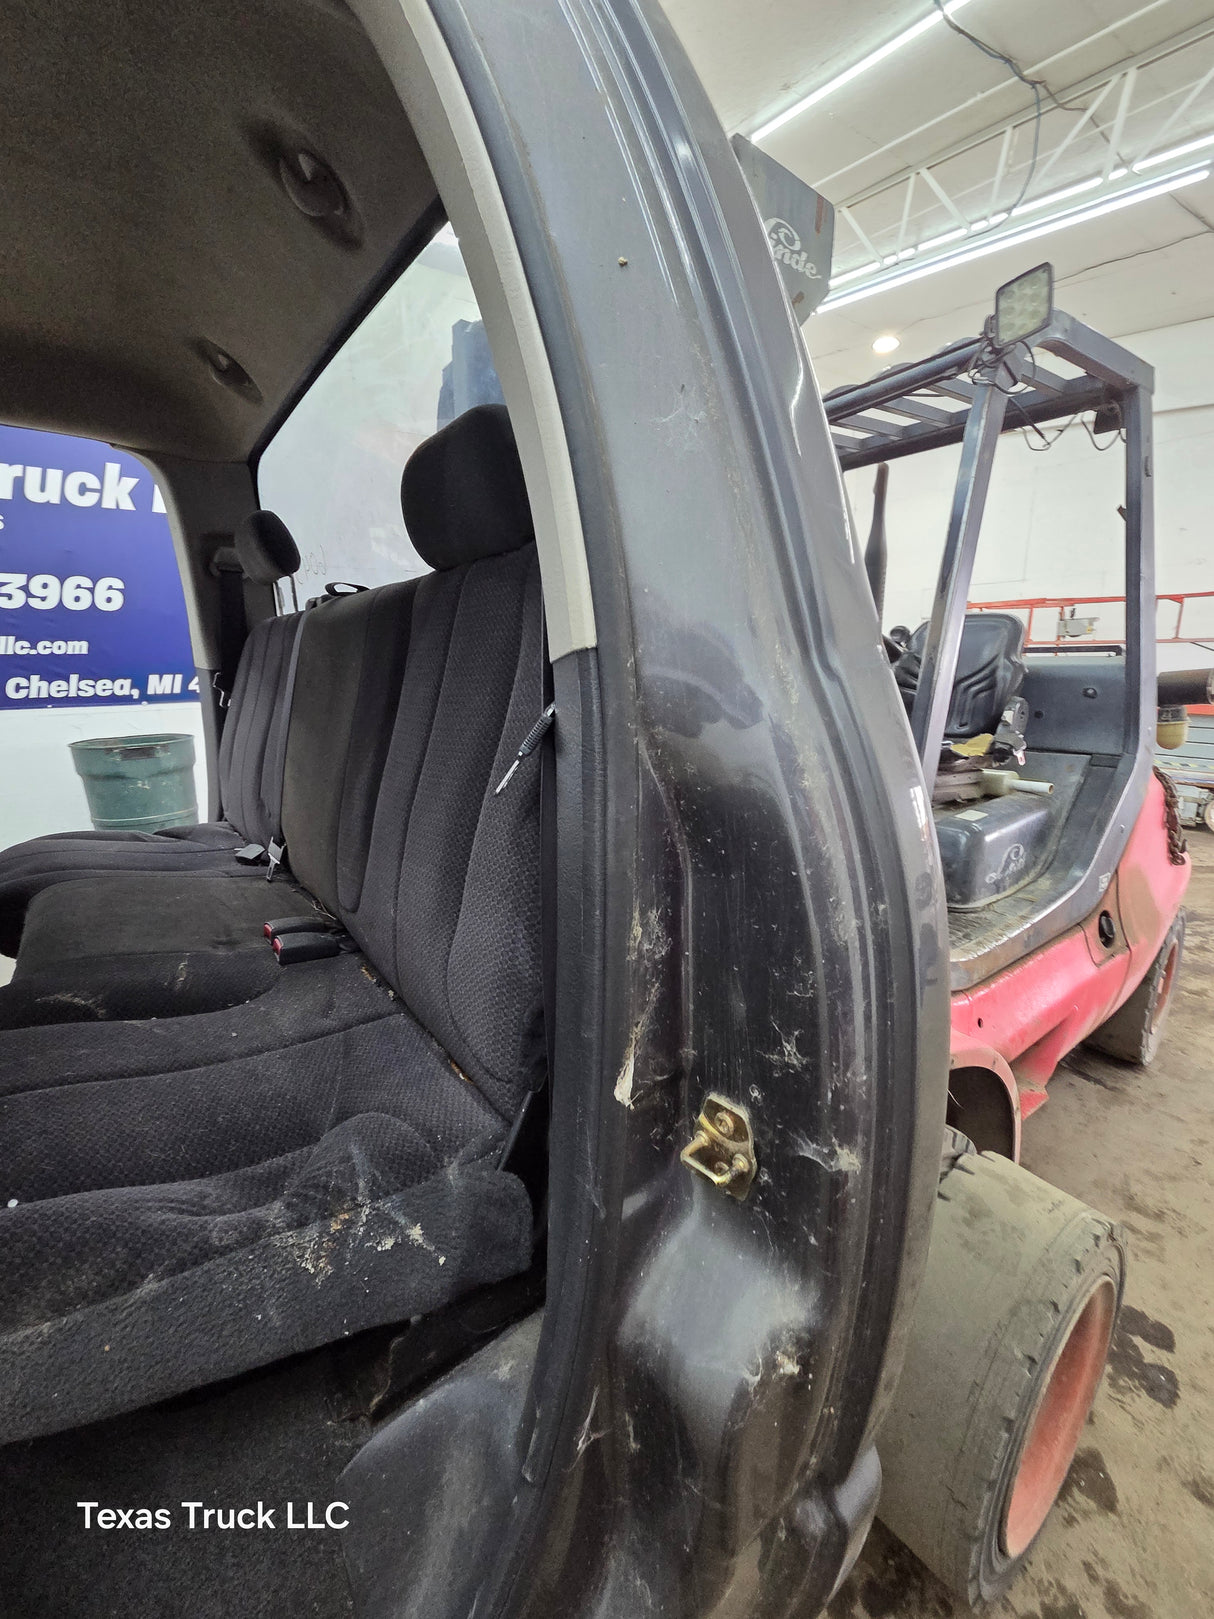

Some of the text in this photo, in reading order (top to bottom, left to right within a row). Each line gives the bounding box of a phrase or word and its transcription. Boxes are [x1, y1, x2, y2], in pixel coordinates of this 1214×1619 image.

[0, 573, 125, 612] 3966
[5, 674, 140, 699] Chelsea,
[147, 674, 183, 695] MI
